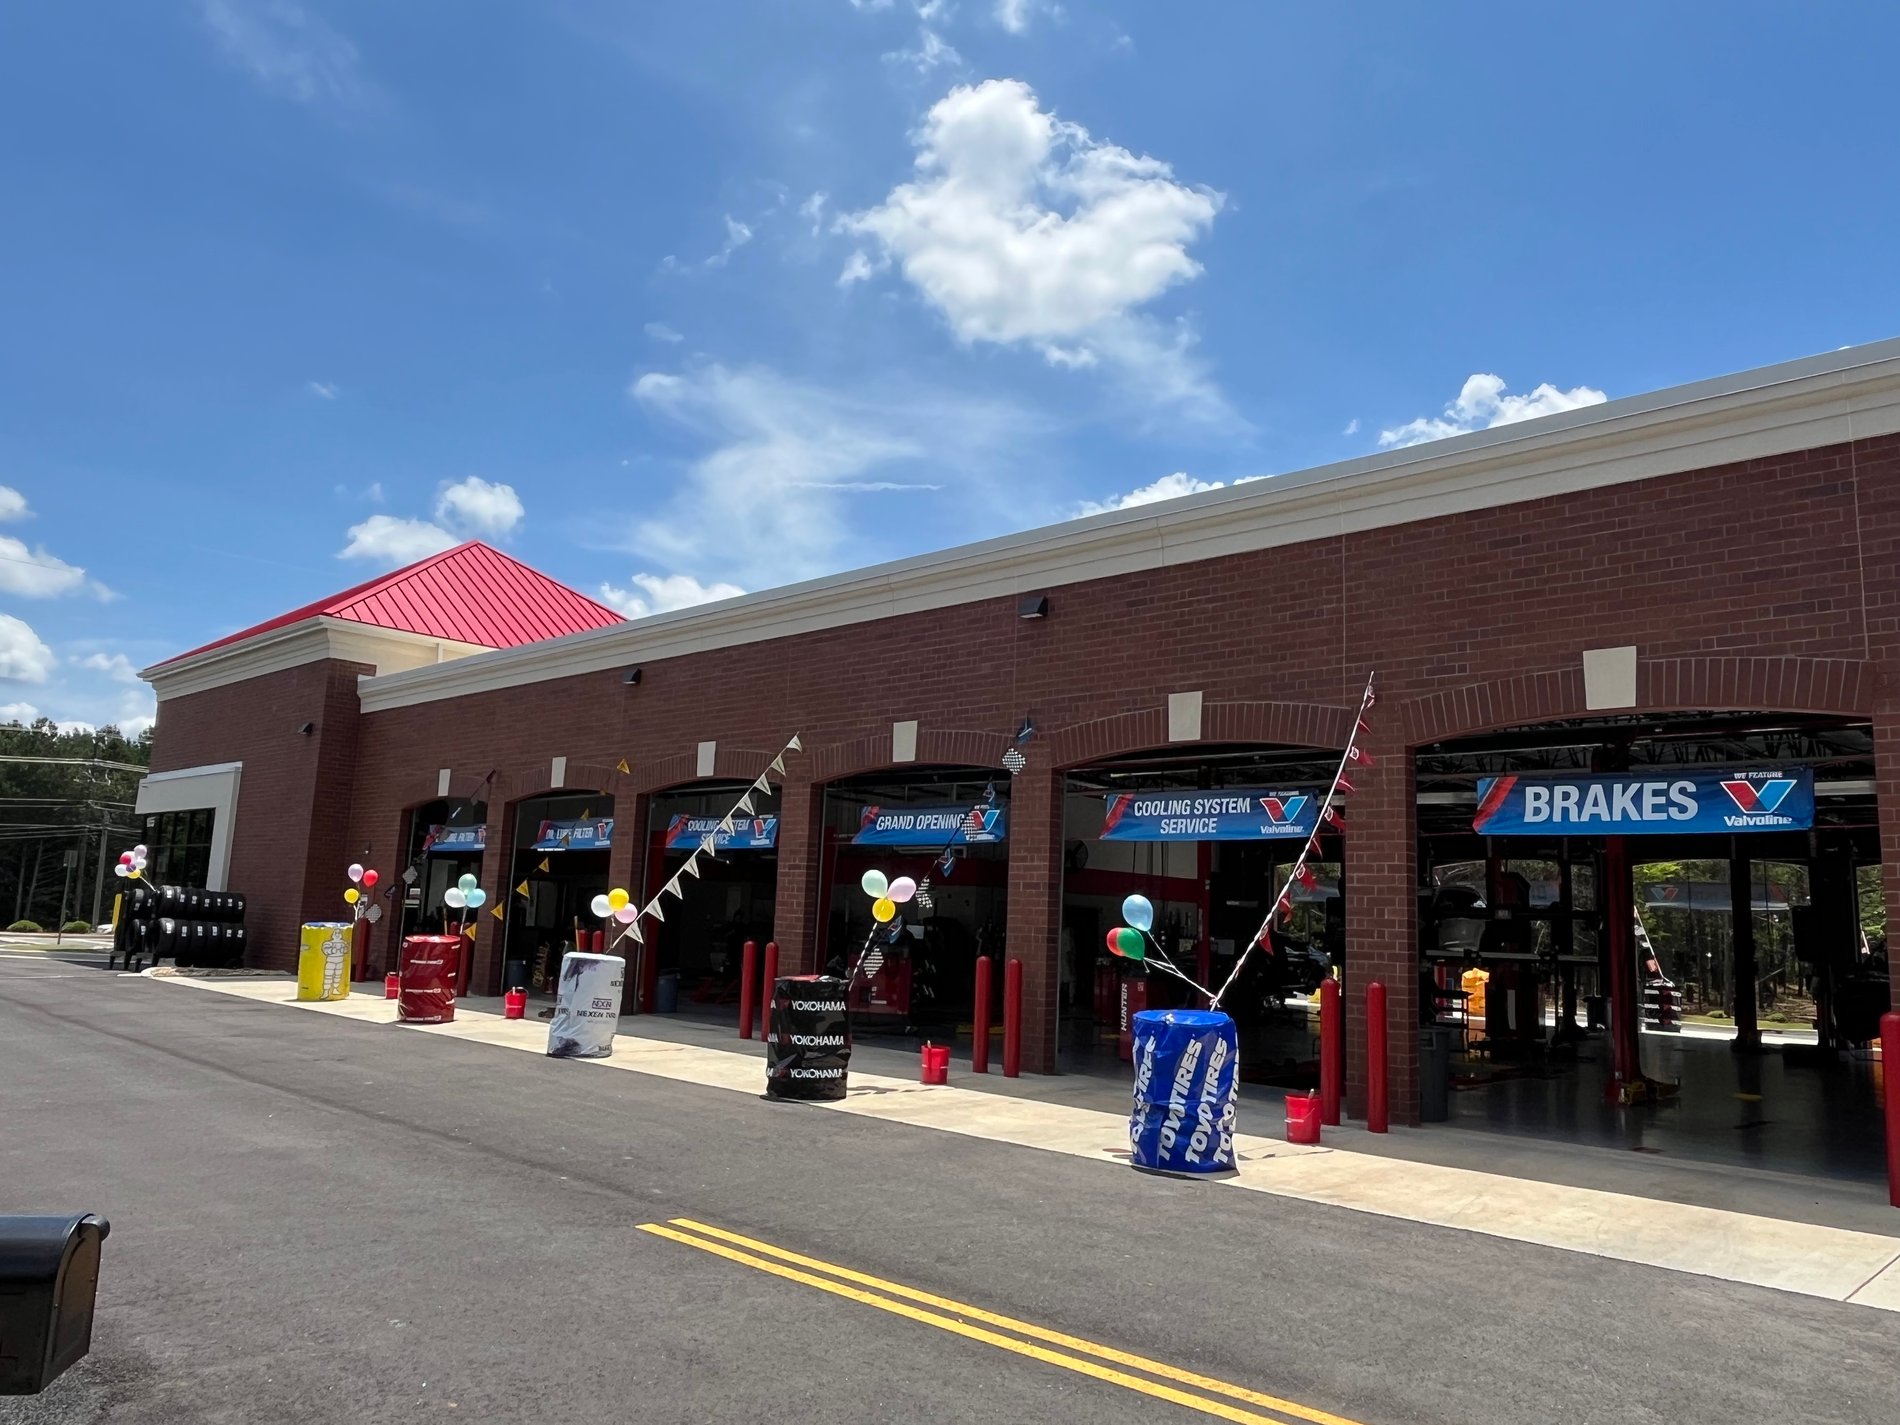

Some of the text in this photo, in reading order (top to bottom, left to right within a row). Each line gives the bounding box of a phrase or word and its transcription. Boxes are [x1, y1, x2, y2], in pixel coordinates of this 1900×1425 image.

[1748, 771, 1783, 779] FEATURE
[1134, 798, 1250, 816] COOLING SYSTEM
[1524, 781, 1698, 823] BRAKES
[876, 815, 914, 830] GRAND
[1160, 818, 1217, 834] SERVICE
[1723, 815, 1793, 827] Valvoline
[573, 827, 594, 839] FILTER
[791, 1000, 847, 1011] YOKOHAMA
[1120, 983, 1128, 1032] HUNTER
[576, 1010, 603, 1018] NEXEN
[790, 1035, 845, 1046] YOKOHAMA
[1169, 1038, 1203, 1104] TIRES
[1185, 1037, 1228, 1164] TOYO TIRES
